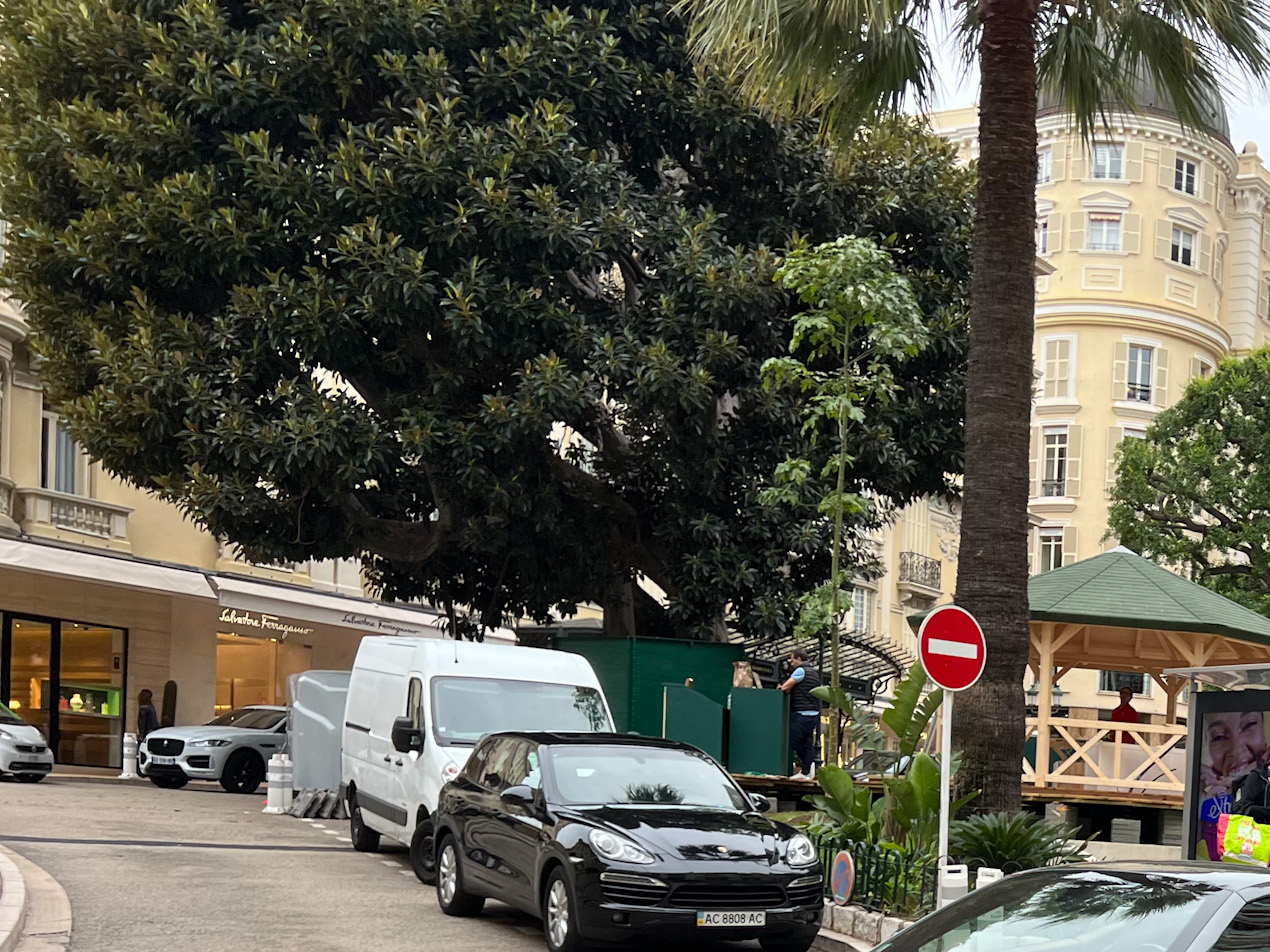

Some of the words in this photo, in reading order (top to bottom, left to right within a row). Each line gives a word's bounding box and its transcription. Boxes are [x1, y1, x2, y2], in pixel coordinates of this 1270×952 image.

[219, 608, 260, 627] Salvatore
[261, 614, 314, 638] Ferragamo
[342, 613, 376, 627] Salvatore
[378, 619, 421, 635] Ferragamo
[704, 913, 720, 924] AC
[722, 913, 746, 924] 8808
[748, 913, 763, 924] AC
